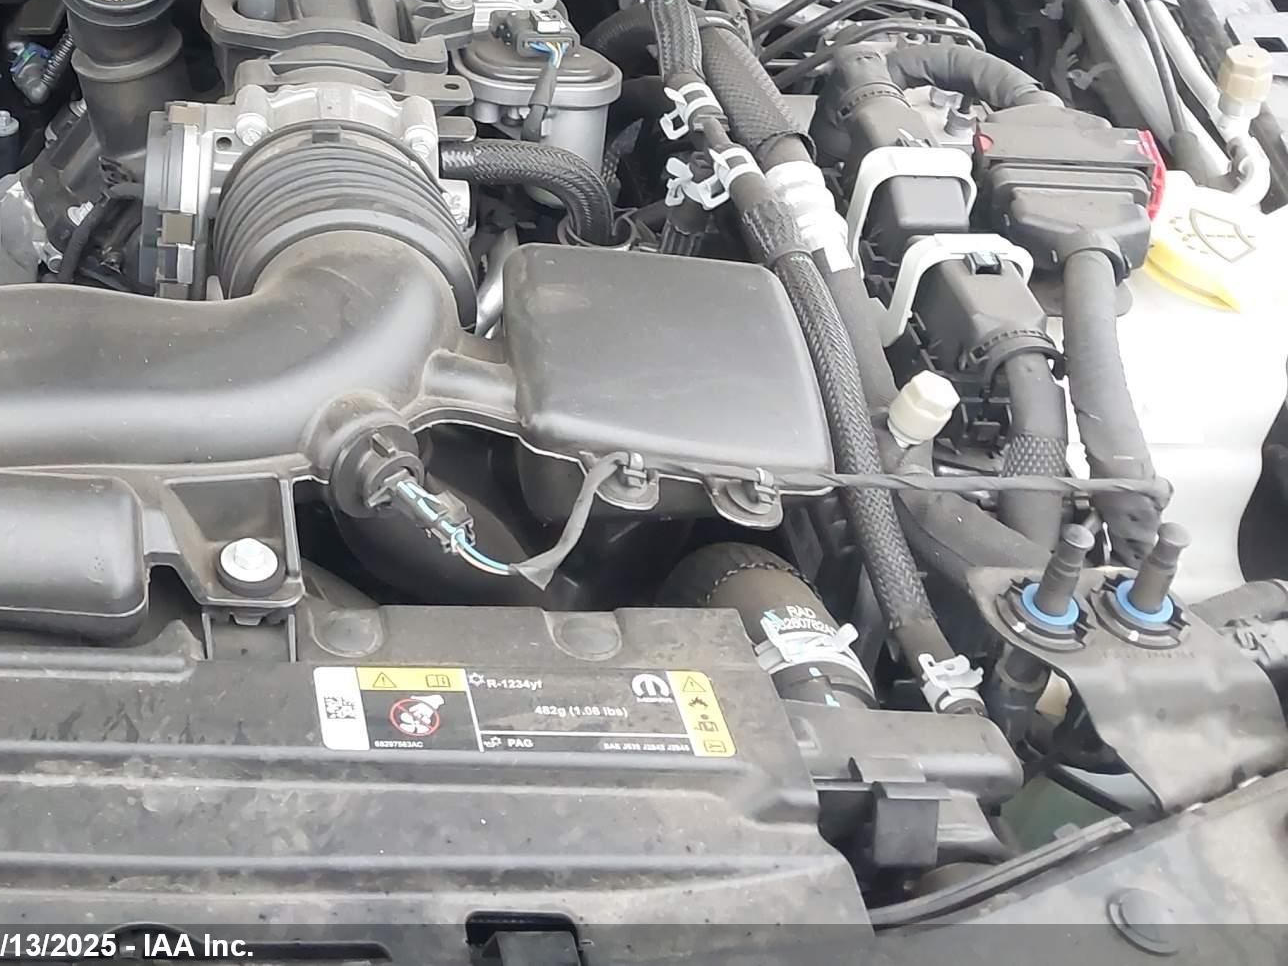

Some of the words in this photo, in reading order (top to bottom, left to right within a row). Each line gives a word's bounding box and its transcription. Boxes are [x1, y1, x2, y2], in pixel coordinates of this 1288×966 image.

[785, 605, 817, 619] RAD
[603, 706, 629, 719] lbs)
[507, 738, 534, 748] PAG
